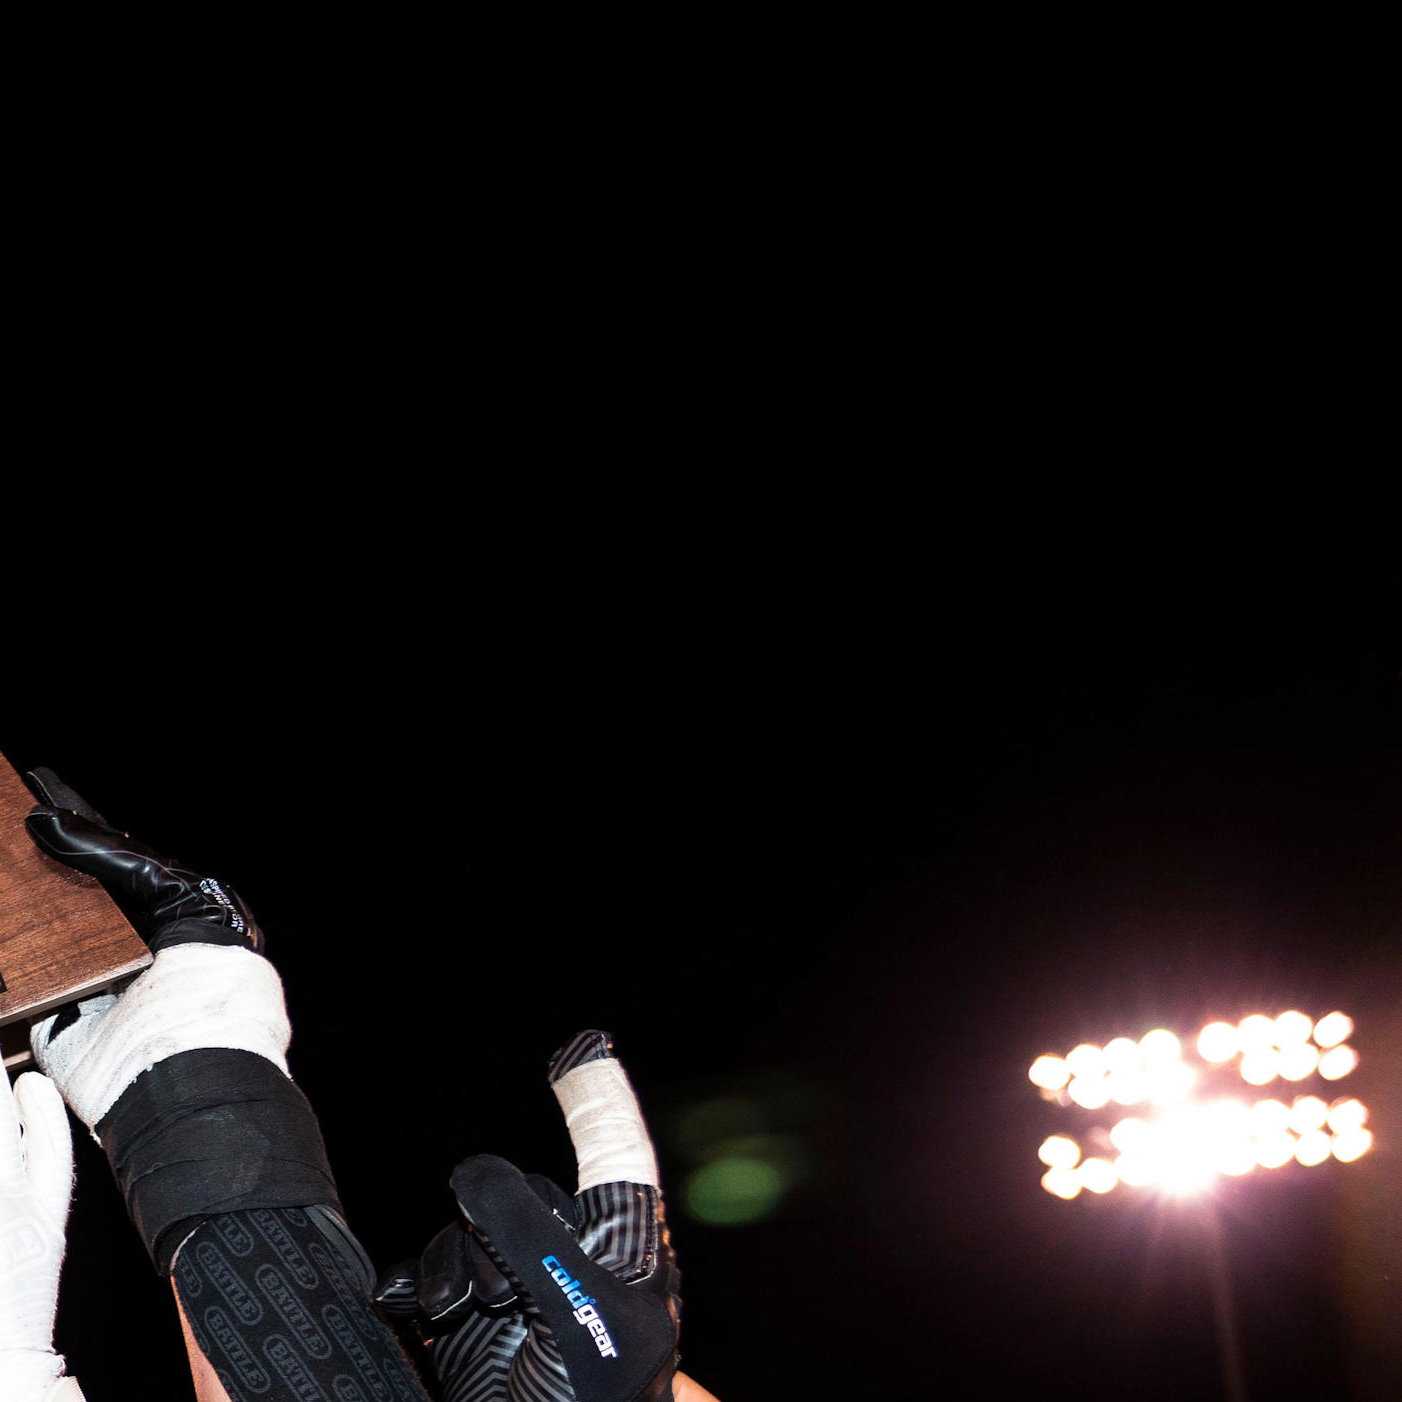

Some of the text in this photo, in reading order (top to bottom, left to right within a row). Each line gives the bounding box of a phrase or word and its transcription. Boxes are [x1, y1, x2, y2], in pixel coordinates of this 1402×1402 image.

[202, 1248, 257, 1317] BATTLE
[261, 1271, 325, 1351] BATTLE
[542, 1256, 617, 1357] coldgear
[208, 1313, 265, 1386] BATTLE
[328, 1312, 388, 1398] BATTLE
